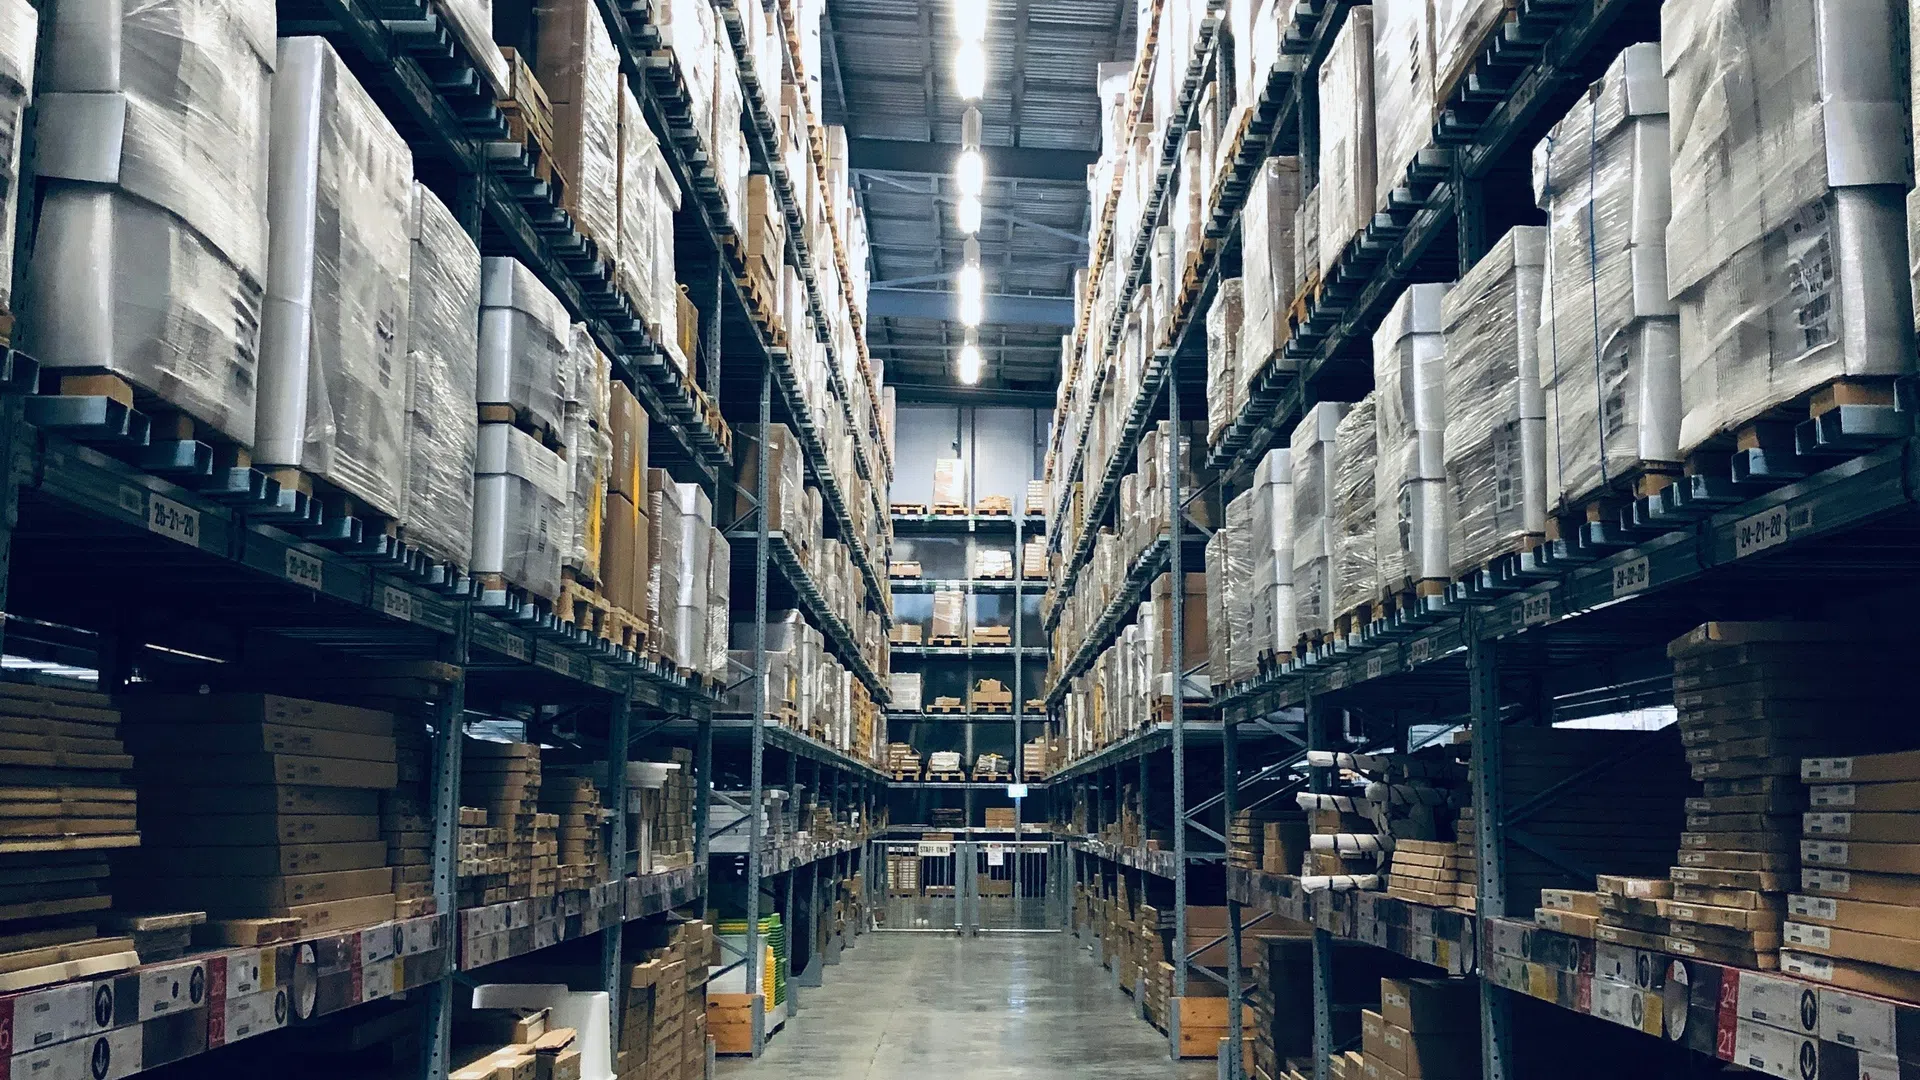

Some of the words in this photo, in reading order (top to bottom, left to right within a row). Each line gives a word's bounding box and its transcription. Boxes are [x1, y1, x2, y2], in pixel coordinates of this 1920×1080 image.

[1741, 512, 1782, 549] 24-21-20
[1720, 982, 1737, 1009] 24
[1718, 1028, 1733, 1056] 21
